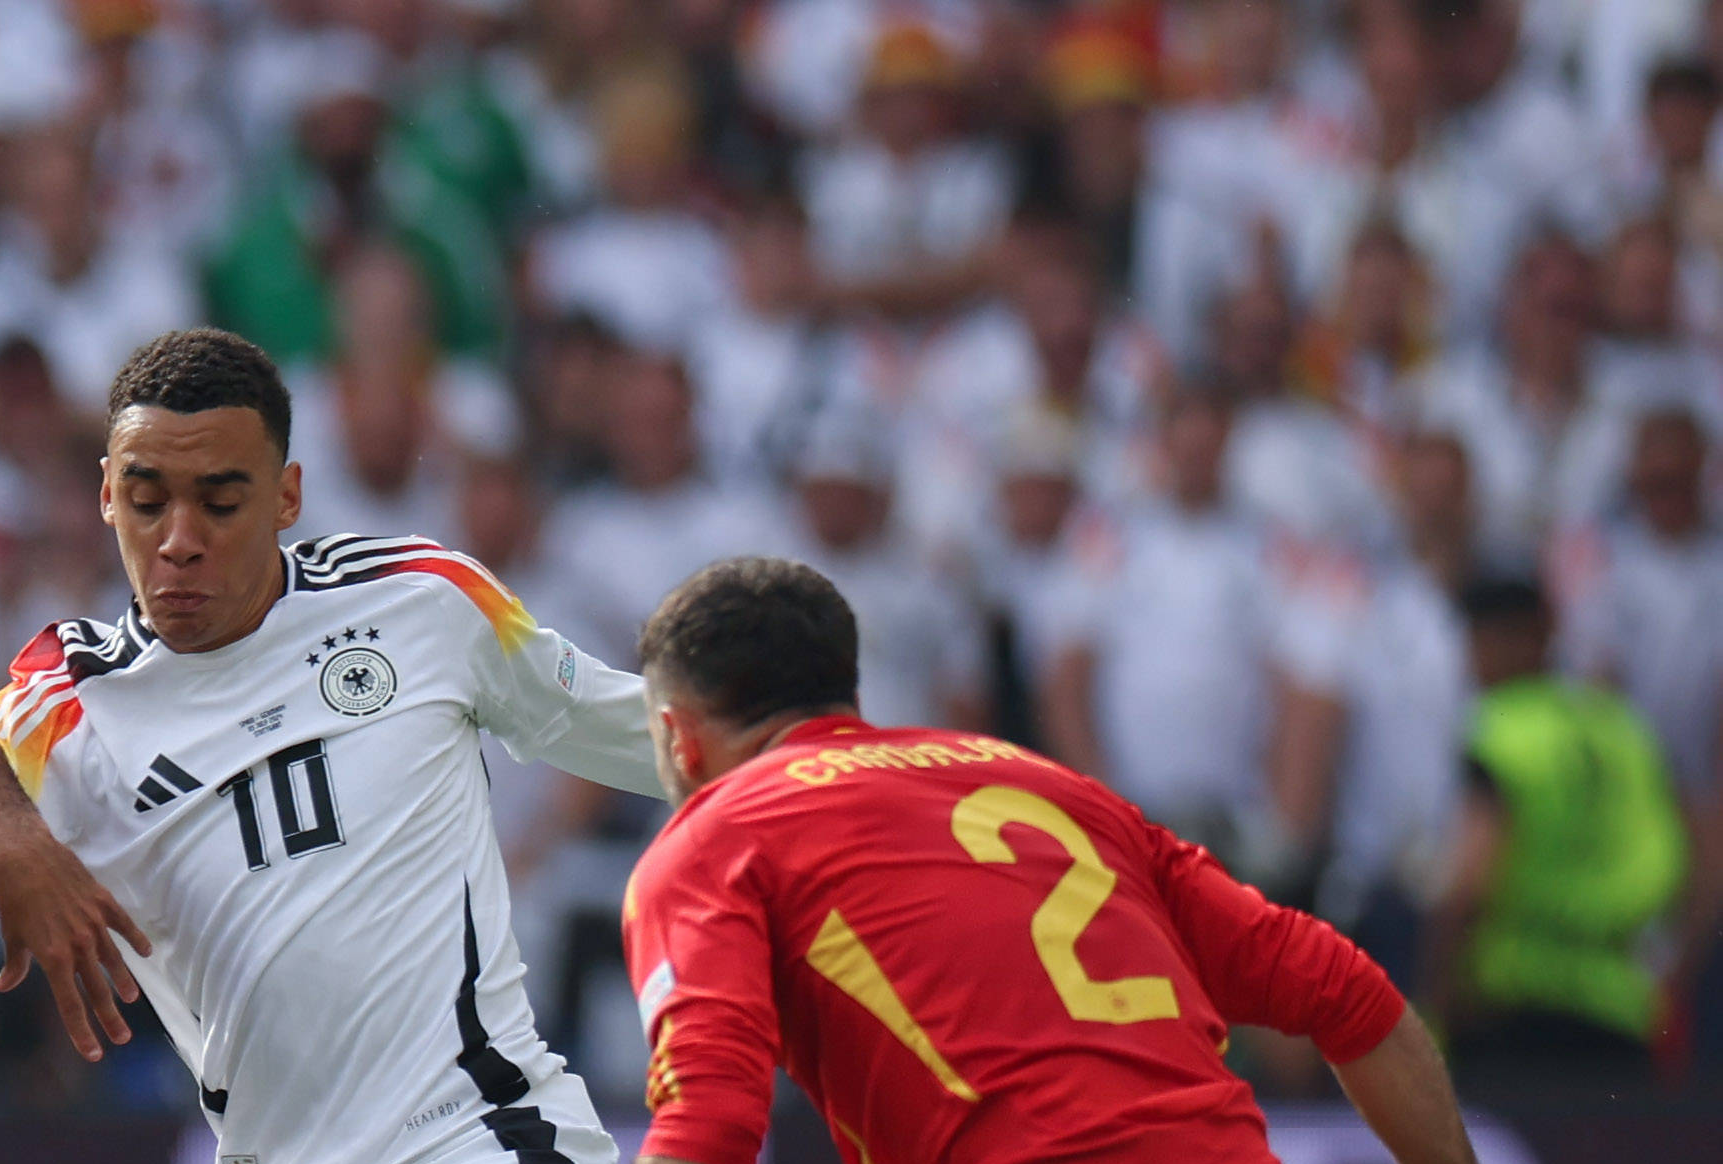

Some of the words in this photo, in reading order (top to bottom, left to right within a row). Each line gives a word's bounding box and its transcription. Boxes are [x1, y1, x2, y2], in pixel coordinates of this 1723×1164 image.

[215, 738, 347, 872] 10
[785, 738, 1056, 786] CARVAJA
[951, 785, 1180, 1025] 2
